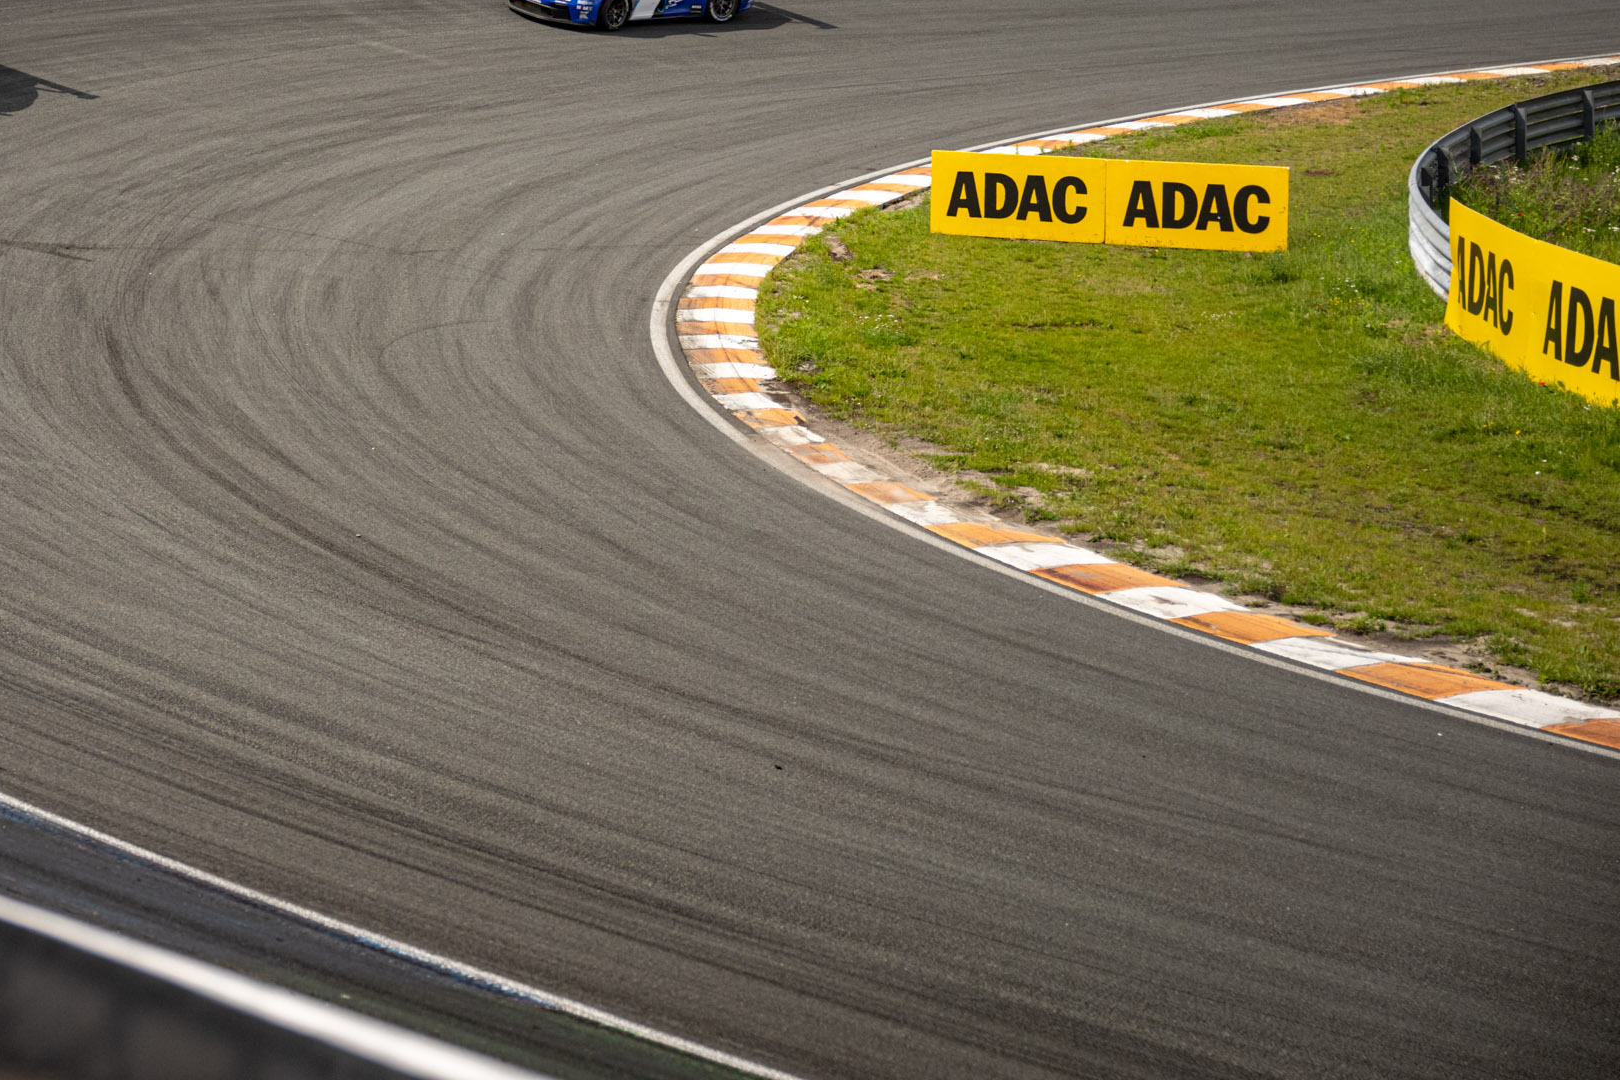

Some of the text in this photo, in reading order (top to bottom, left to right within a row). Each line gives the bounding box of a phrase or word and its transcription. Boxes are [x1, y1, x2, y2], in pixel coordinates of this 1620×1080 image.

[946, 171, 1088, 225] ADAC
[1123, 180, 1271, 234] ADAC
[1457, 235, 1514, 336] ADAC
